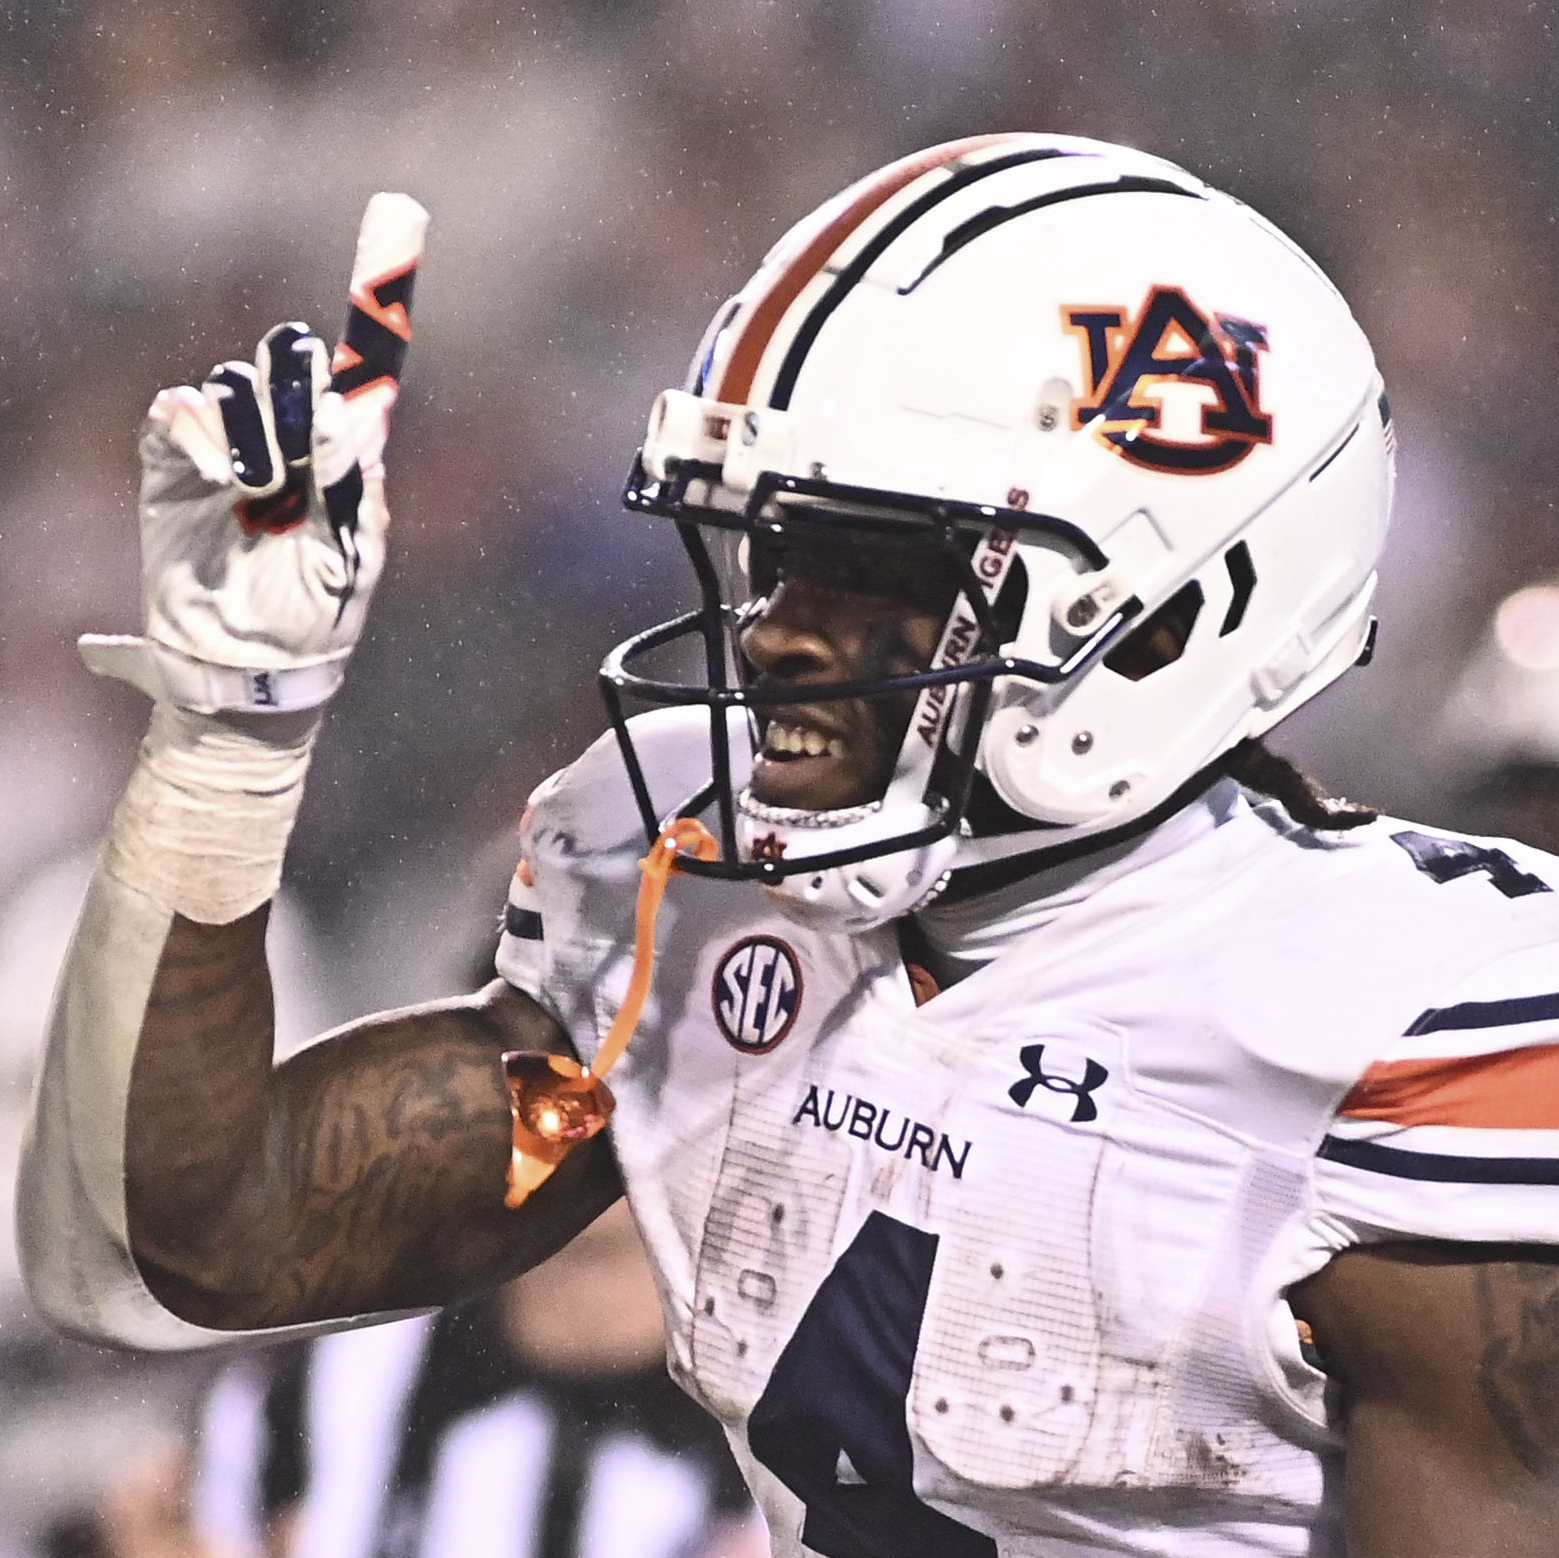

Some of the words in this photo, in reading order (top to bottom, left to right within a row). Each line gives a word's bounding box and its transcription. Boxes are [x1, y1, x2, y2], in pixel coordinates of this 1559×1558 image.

[1389, 830, 1554, 898] 4
[720, 943, 796, 1045] SEC
[791, 1084, 973, 1180] AUBURN
